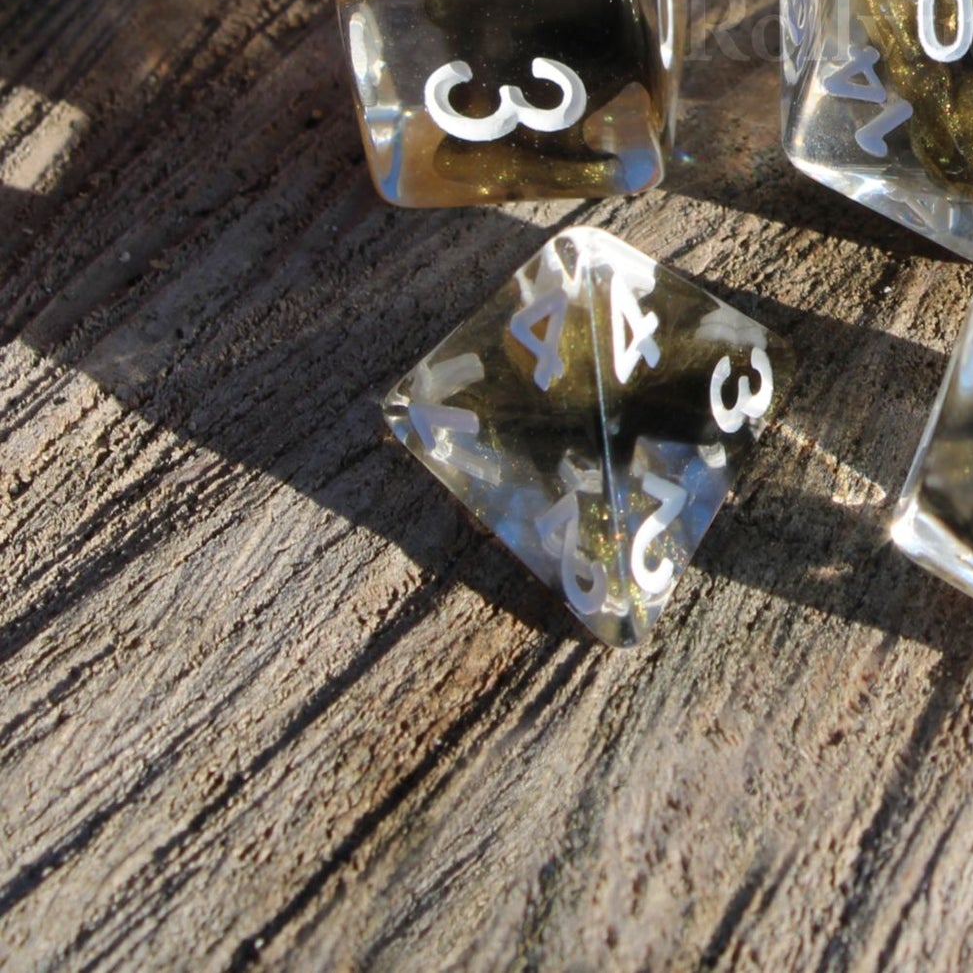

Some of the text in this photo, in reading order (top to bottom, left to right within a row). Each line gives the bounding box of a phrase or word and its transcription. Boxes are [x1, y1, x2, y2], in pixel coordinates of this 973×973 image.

[424, 57, 588, 142] 3
[510, 288, 569, 391] 4
[611, 267, 661, 385] 4
[709, 347, 775, 434] 3
[631, 472, 688, 595] 2
